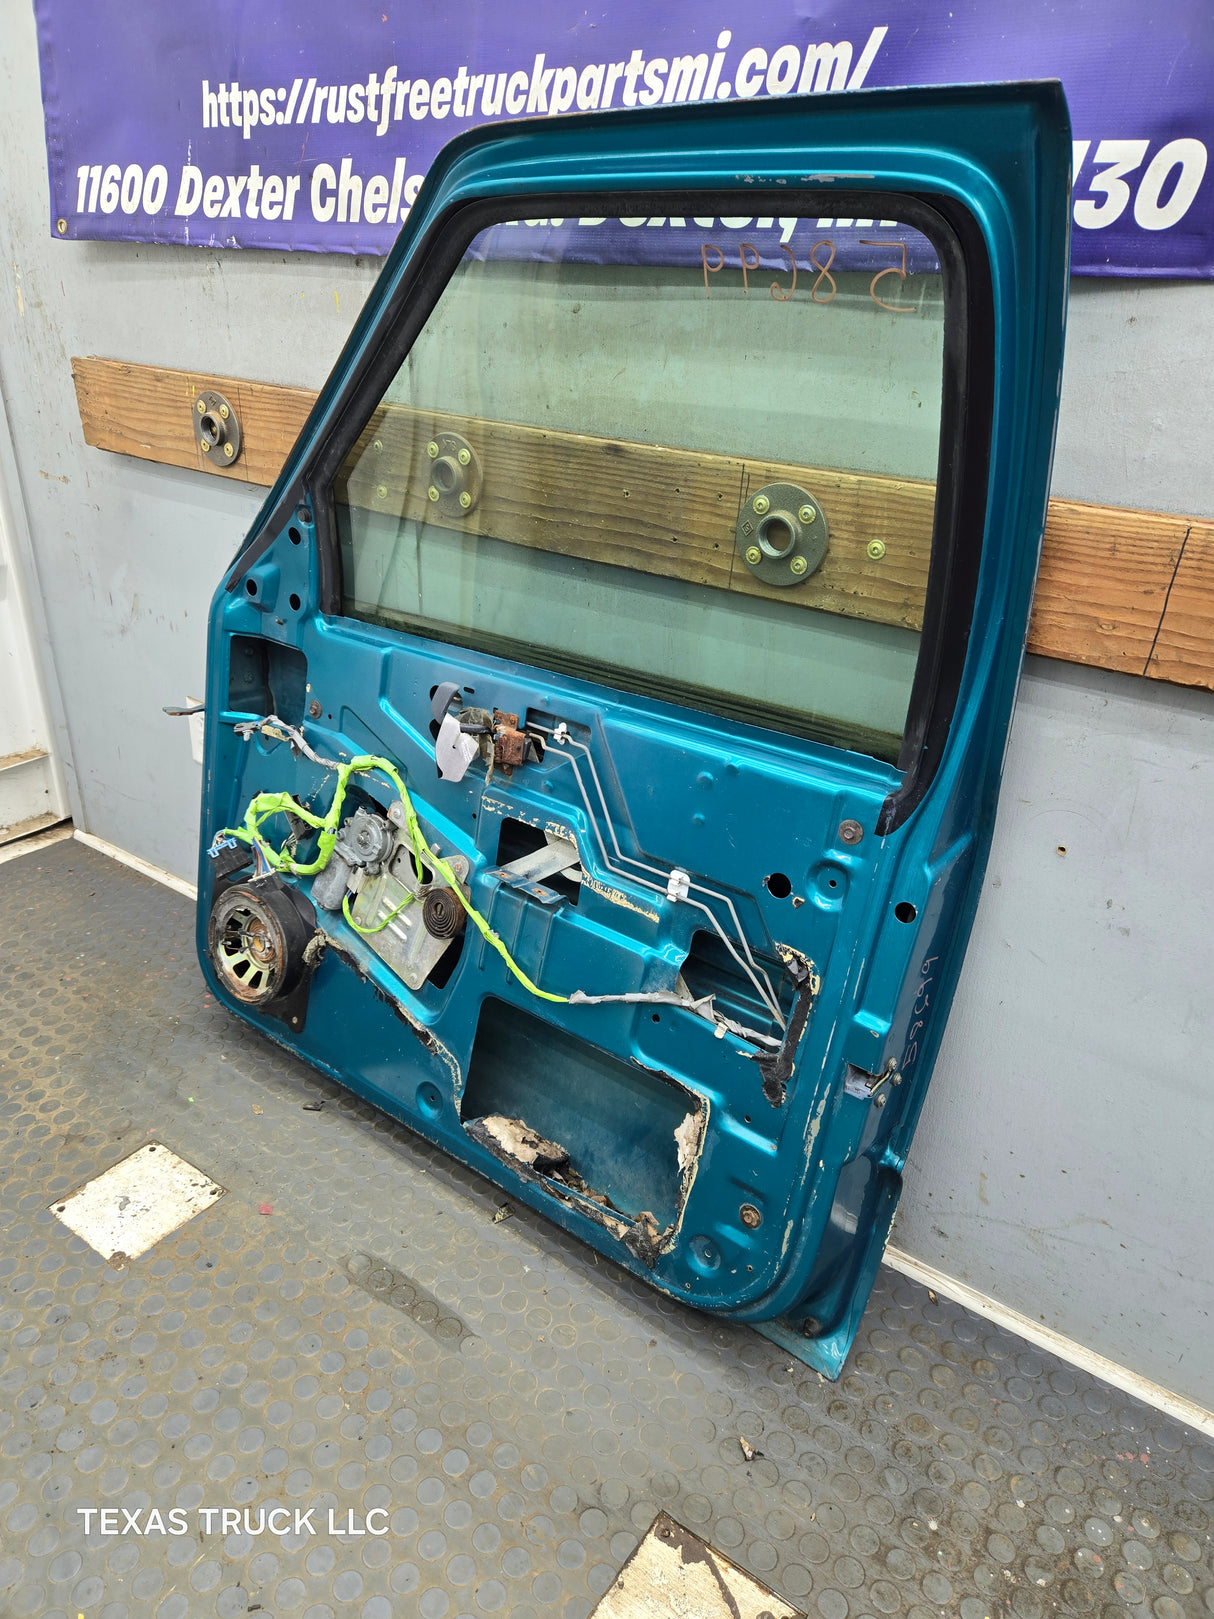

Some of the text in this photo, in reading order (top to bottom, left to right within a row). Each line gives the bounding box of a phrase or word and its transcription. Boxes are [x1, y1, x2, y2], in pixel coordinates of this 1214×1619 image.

[202, 27, 888, 139] https://rustfreetruckpartsmi.com/
[76, 164, 168, 214] 11600
[175, 165, 300, 218] Dexter
